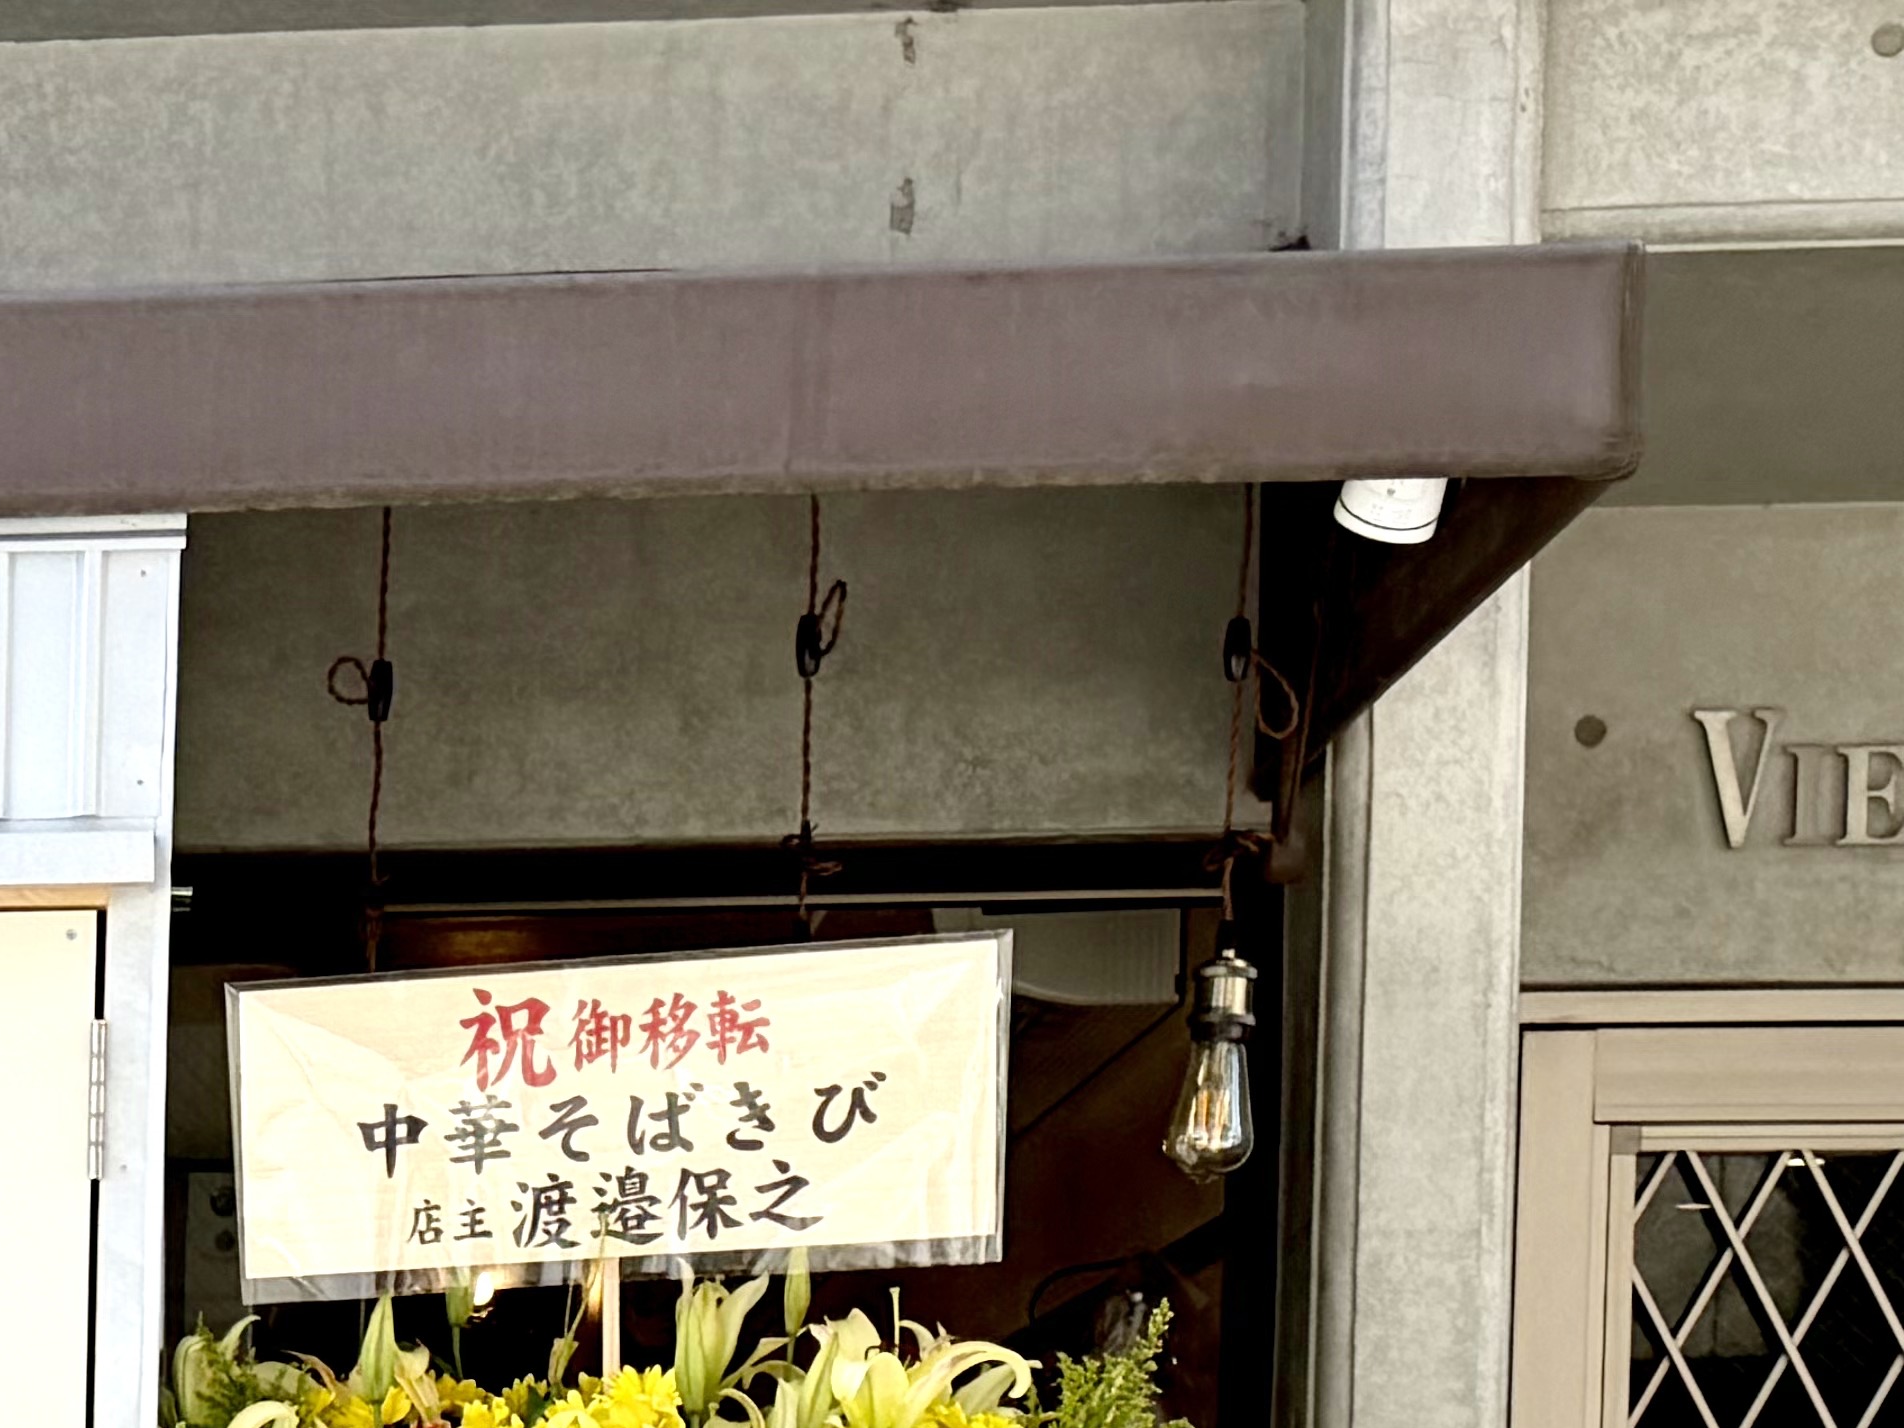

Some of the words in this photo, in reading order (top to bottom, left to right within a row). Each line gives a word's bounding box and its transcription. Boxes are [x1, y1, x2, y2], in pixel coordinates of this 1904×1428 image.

[357, 1071, 887, 1179] 中華そばきび
